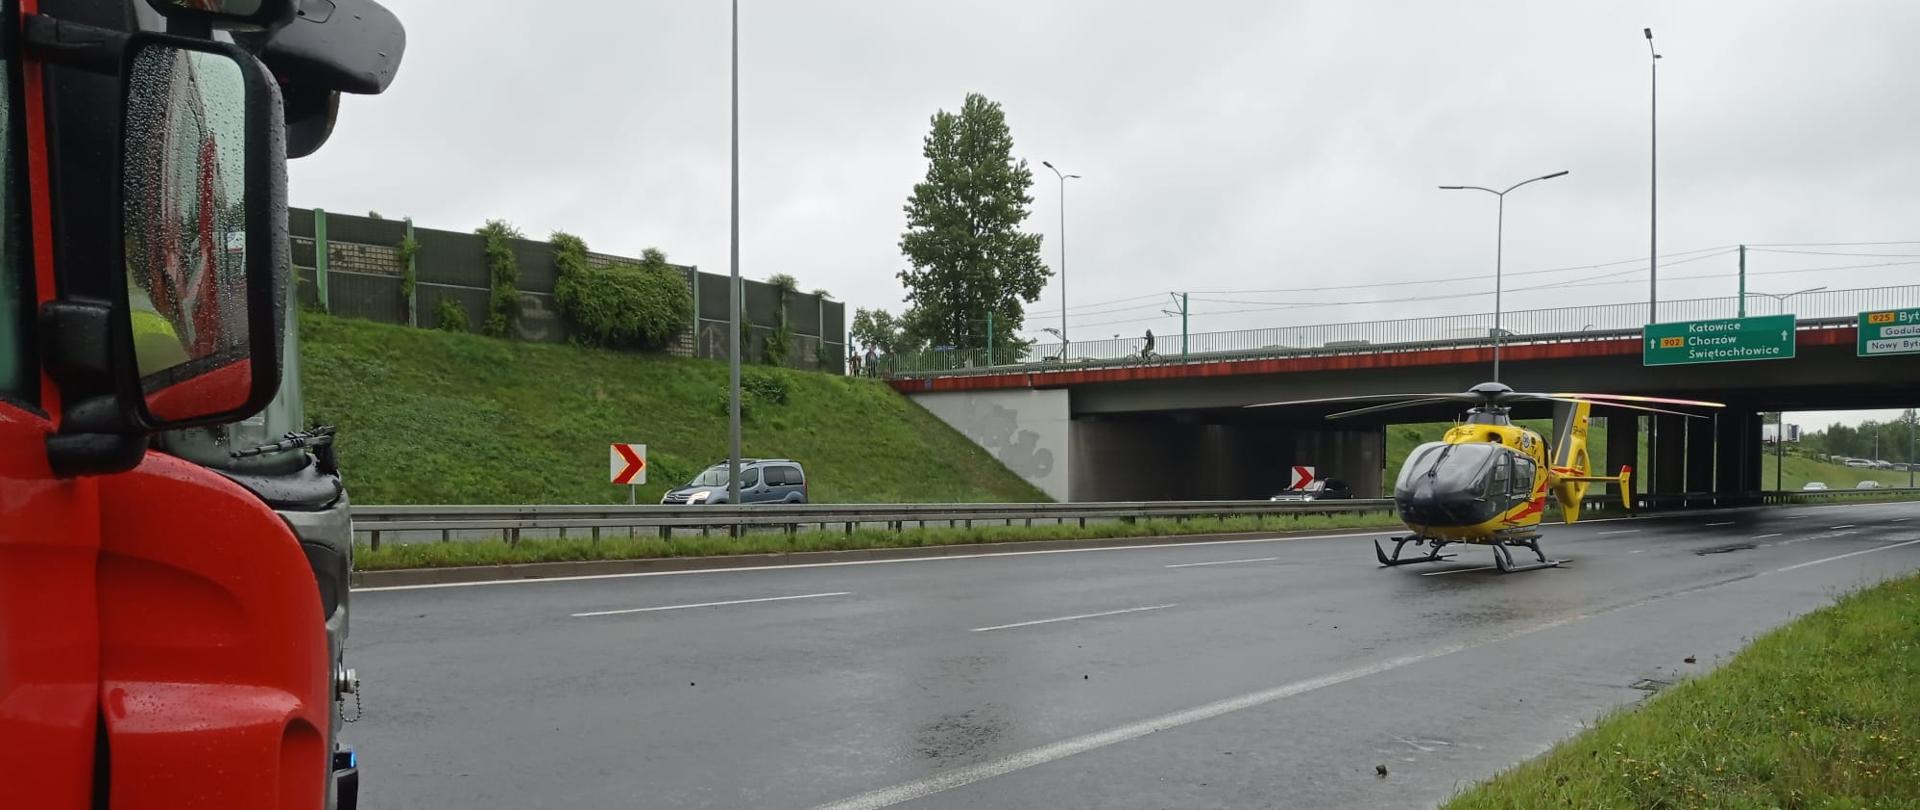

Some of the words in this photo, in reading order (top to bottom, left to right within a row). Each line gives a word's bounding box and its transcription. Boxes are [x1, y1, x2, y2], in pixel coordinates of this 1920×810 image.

[1872, 313, 1890, 322] 925
[1689, 322, 1741, 333] Katowice
[1664, 338, 1680, 347] 902
[1688, 335, 1737, 346] Chorzów
[1871, 342, 1897, 350] Nowy
[1689, 346, 1780, 359] Świętochłowice
